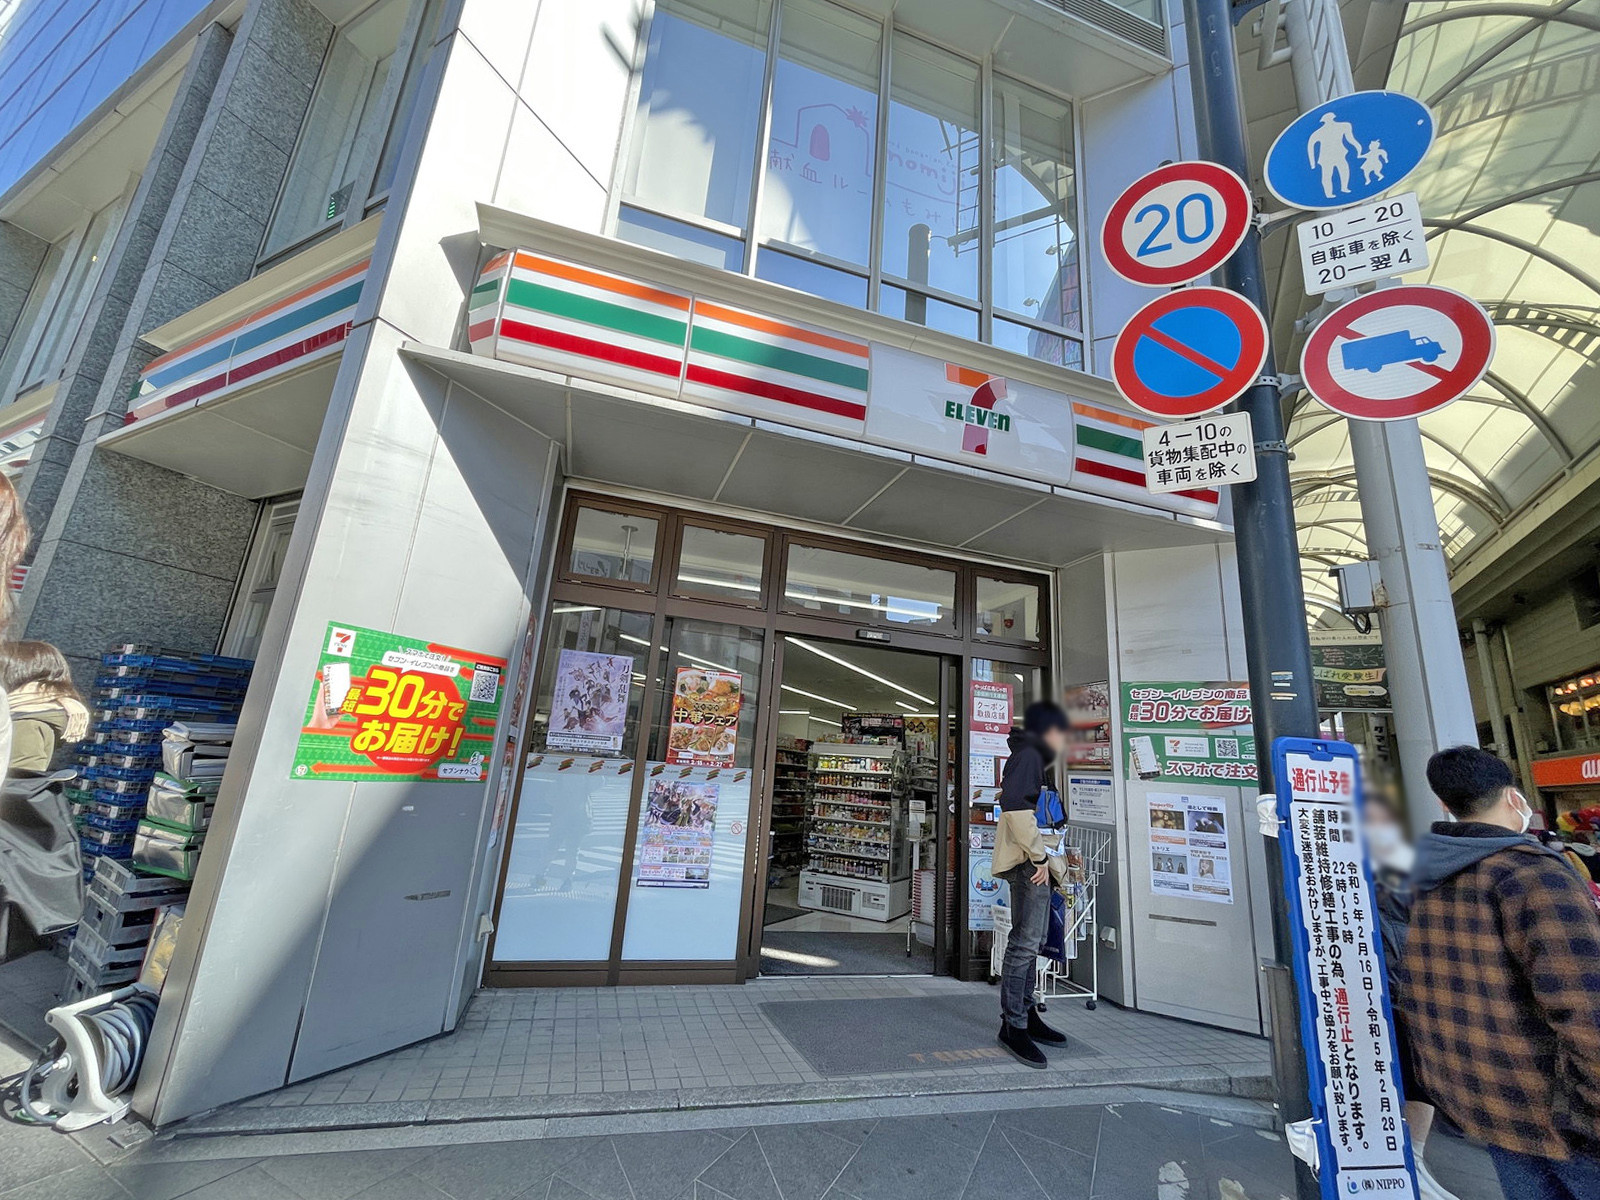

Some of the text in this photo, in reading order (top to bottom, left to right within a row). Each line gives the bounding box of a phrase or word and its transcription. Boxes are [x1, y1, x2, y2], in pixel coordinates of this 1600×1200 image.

[1134, 193, 1215, 258] 20
[1311, 229, 1414, 266] 自転車を除く
[1148, 442, 1247, 468] 貨物集配中の
[1156, 463, 1241, 485] 車両を除く
[674, 707, 739, 727] 中華フェア
[977, 701, 1005, 711] クーポン
[442, 766, 470, 775] セブンナウ
